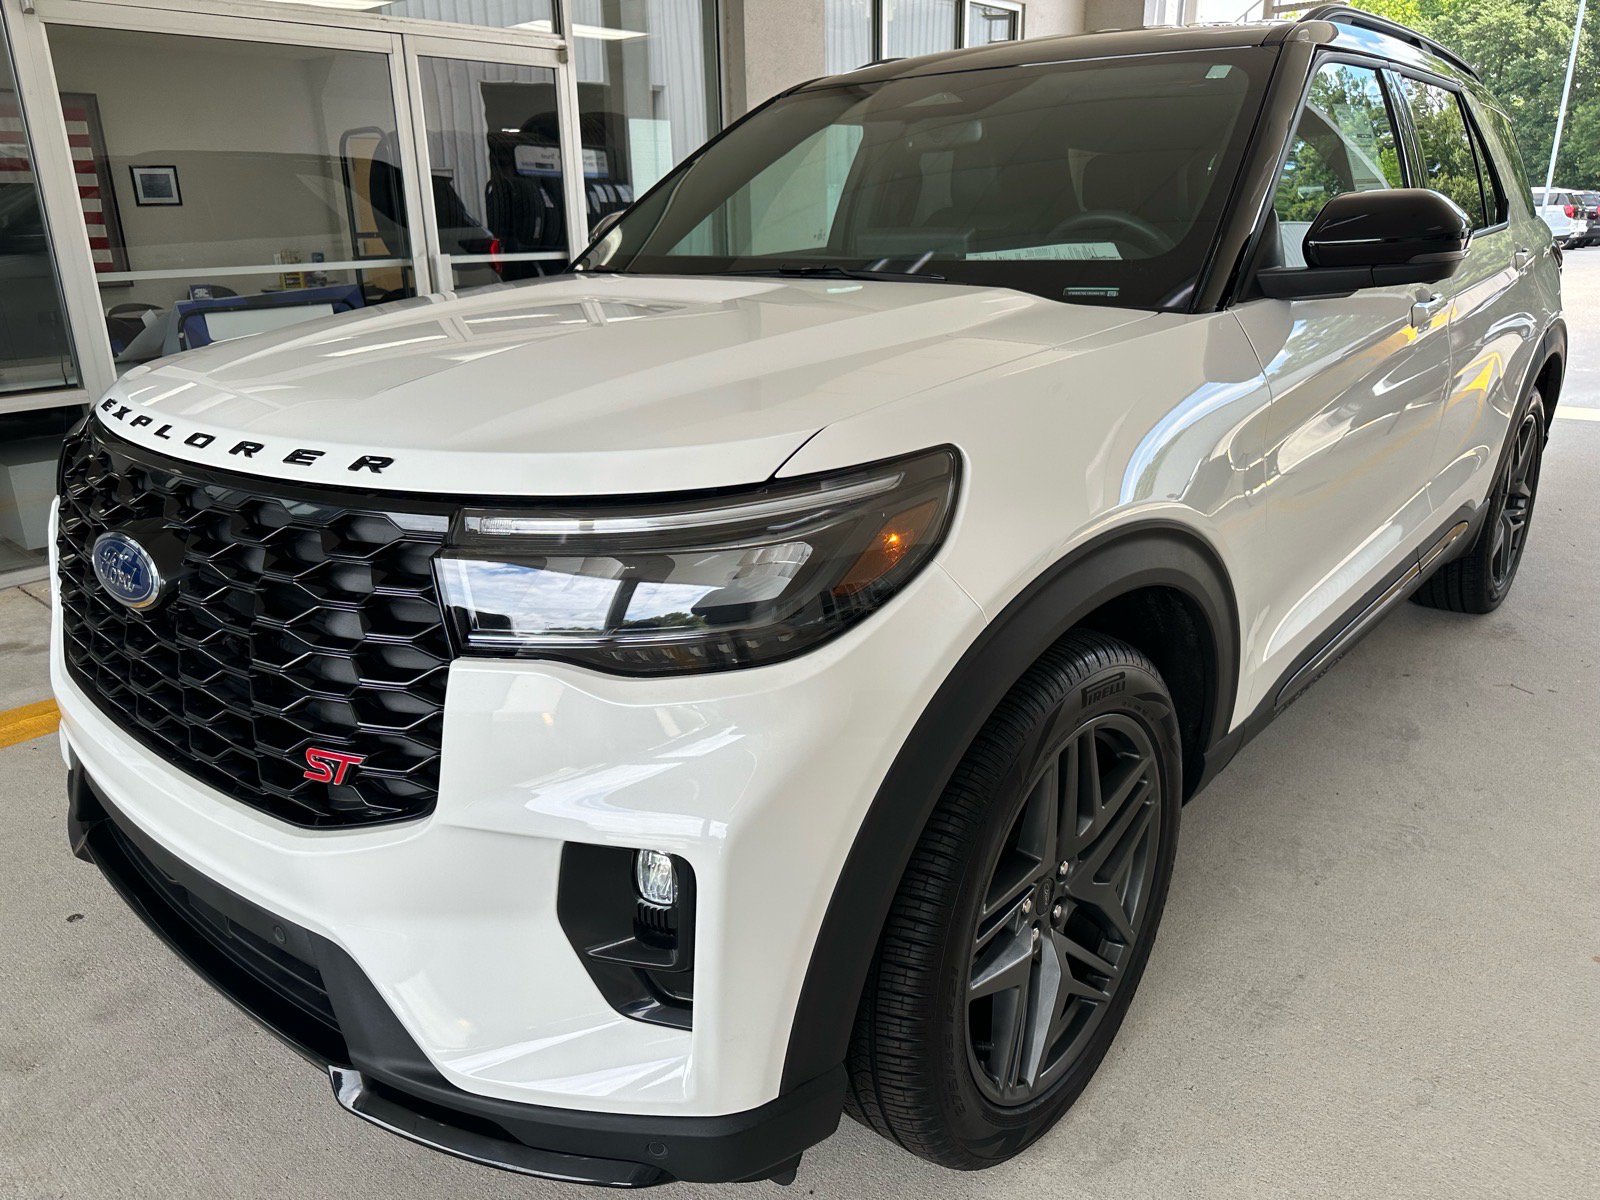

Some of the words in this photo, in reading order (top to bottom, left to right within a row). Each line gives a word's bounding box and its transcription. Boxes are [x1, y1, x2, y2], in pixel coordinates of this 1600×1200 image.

[101, 399, 394, 473] EXPLORER
[100, 546, 136, 592] Ford
[1081, 671, 1126, 709] PIRELLI
[303, 747, 365, 785] ST
